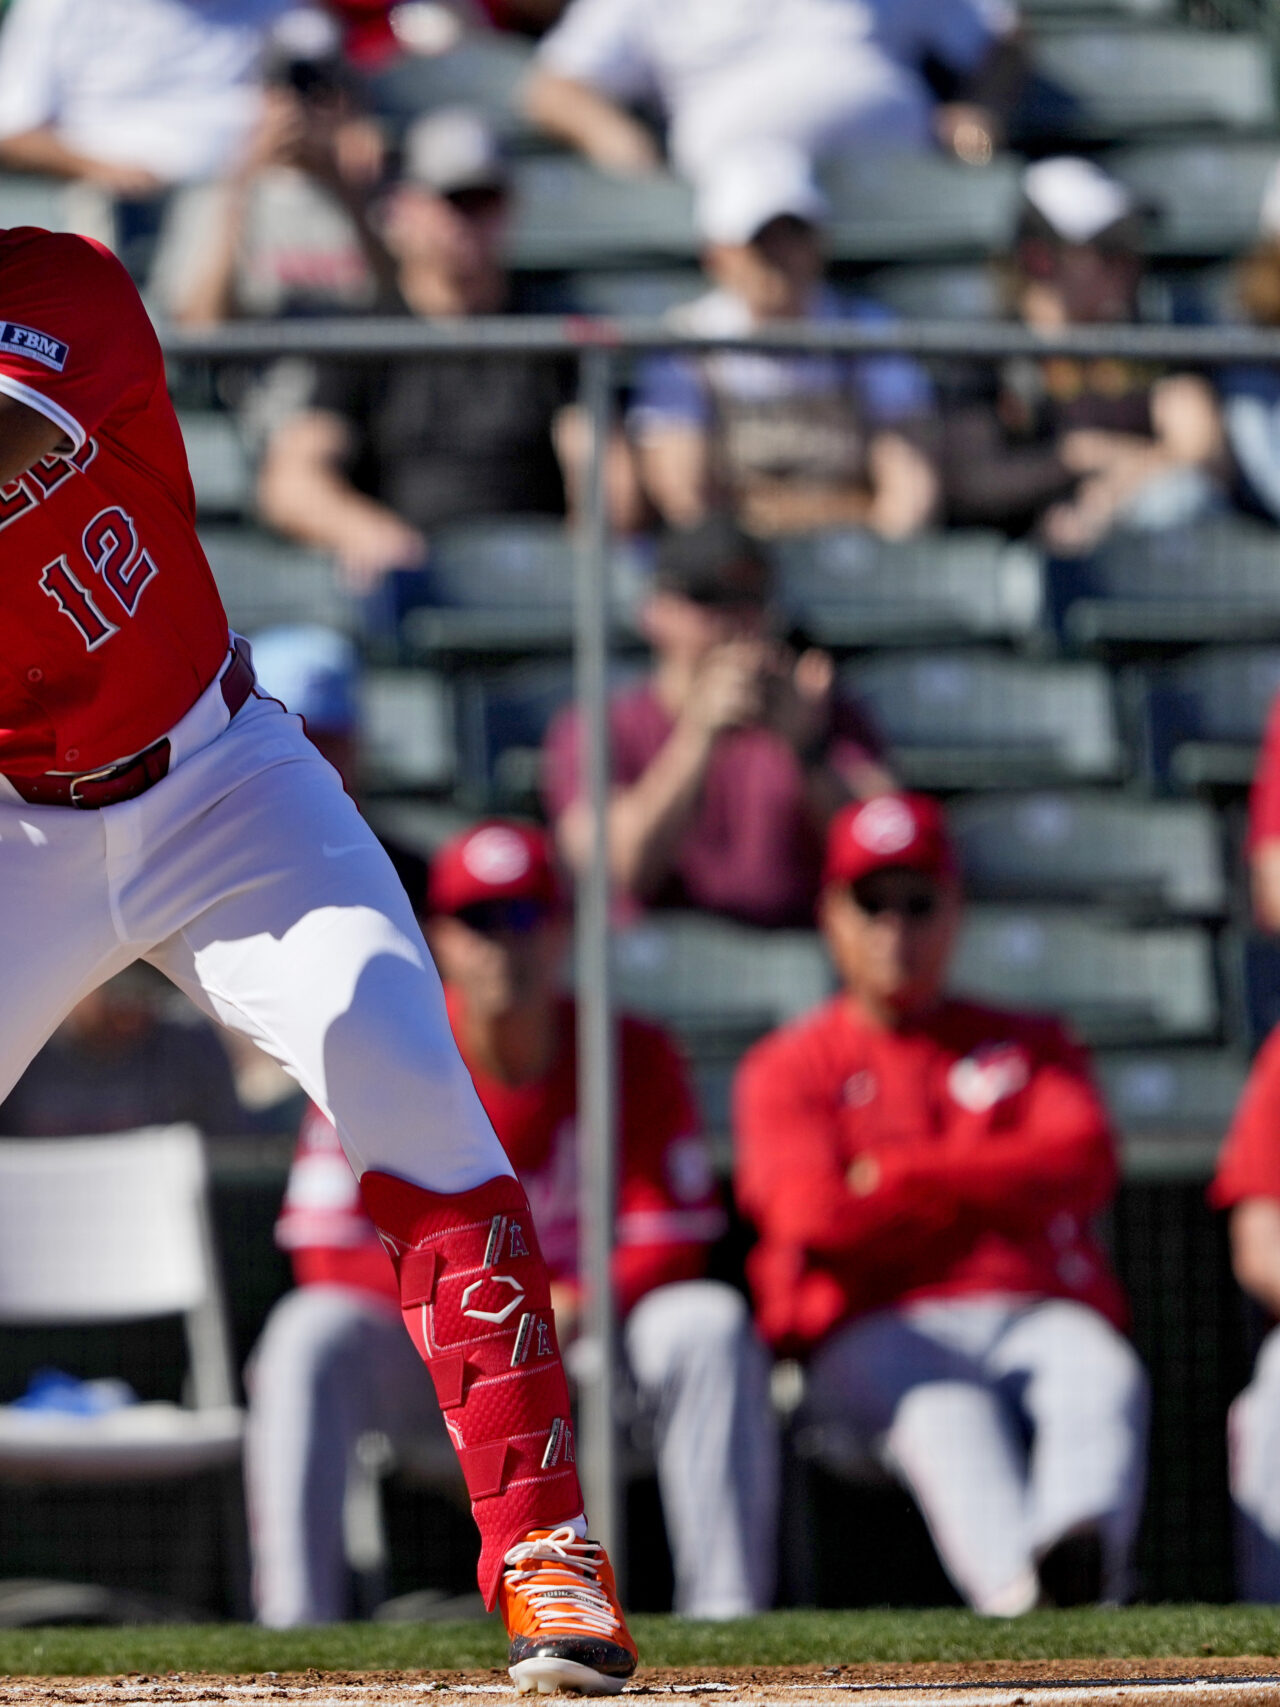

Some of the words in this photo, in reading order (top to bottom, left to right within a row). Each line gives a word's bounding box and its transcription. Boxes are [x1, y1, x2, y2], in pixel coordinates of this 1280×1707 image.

[10, 327, 60, 359] FBM
[38, 506, 159, 652] 12
[510, 1220, 529, 1257] A
[537, 1318, 554, 1355] A
